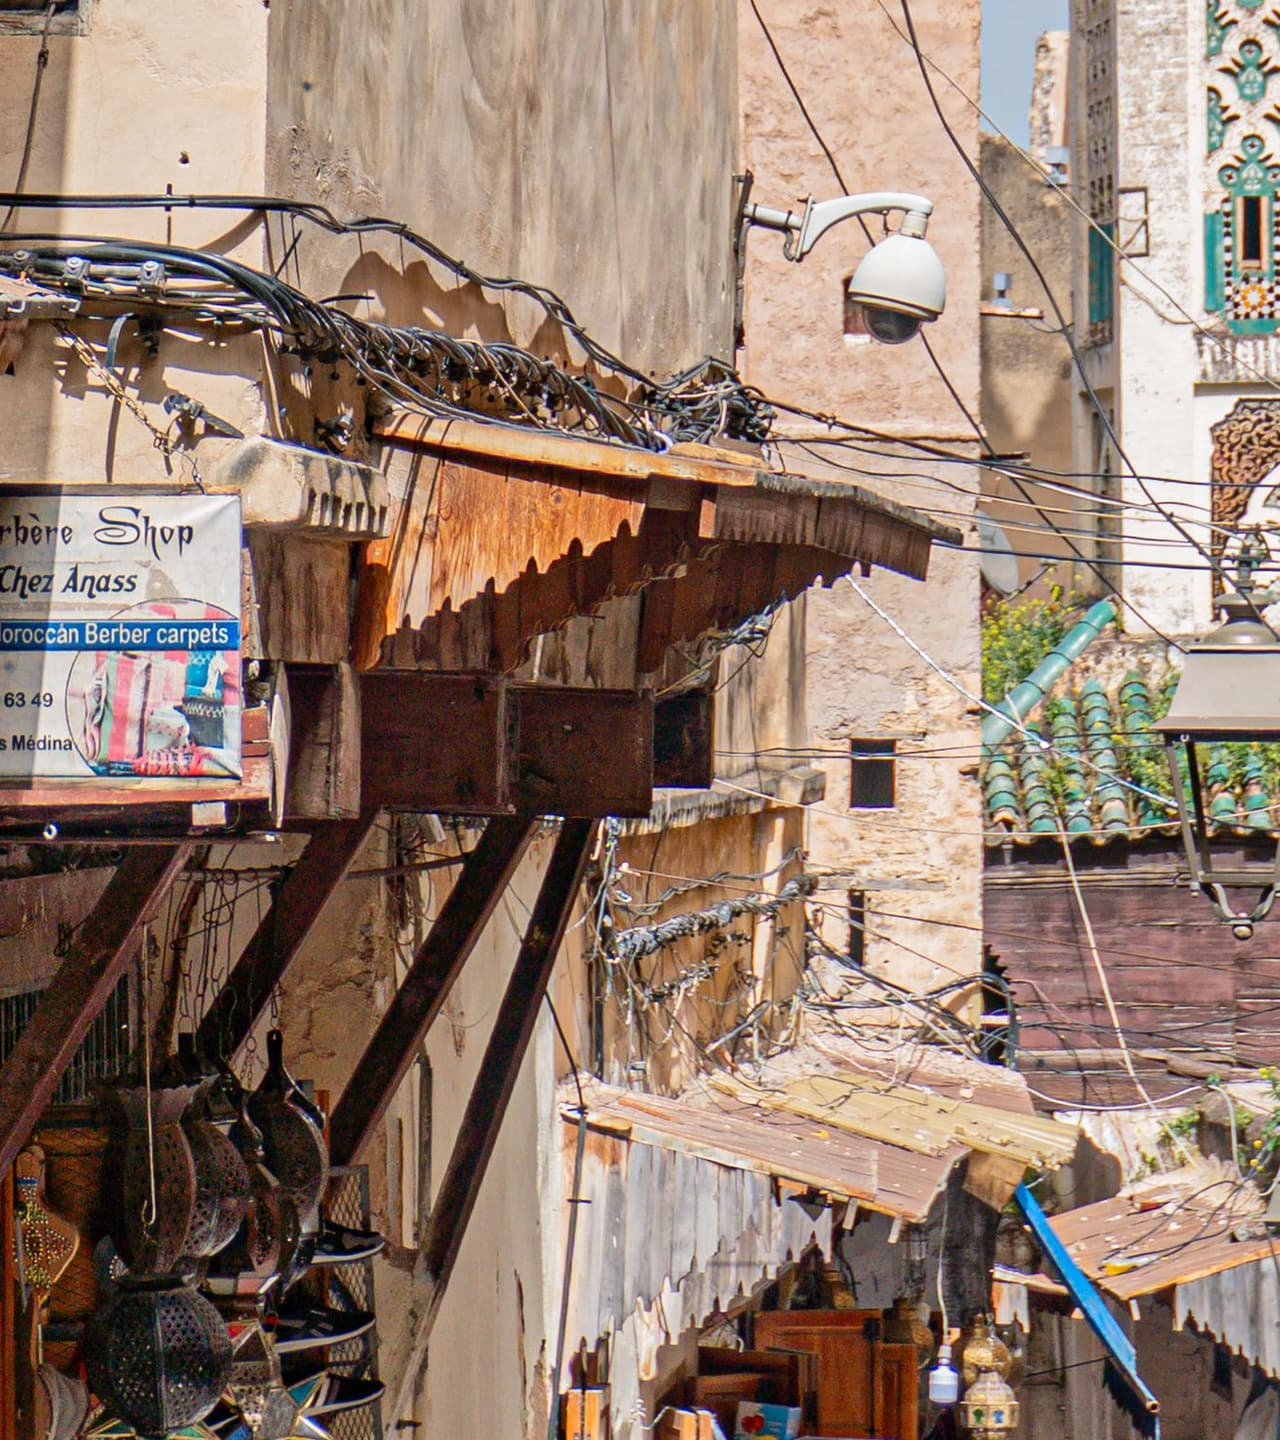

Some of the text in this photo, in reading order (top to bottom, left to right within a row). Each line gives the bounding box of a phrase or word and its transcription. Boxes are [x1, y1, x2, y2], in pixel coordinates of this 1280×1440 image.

[93, 505, 194, 561] Shop
[61, 563, 138, 600] Anass
[84, 622, 151, 645] Berber
[156, 622, 229, 649] carpets
[4, 692, 26, 708] 63
[30, 692, 53, 708] 49
[11, 734, 73, 752] Médina
